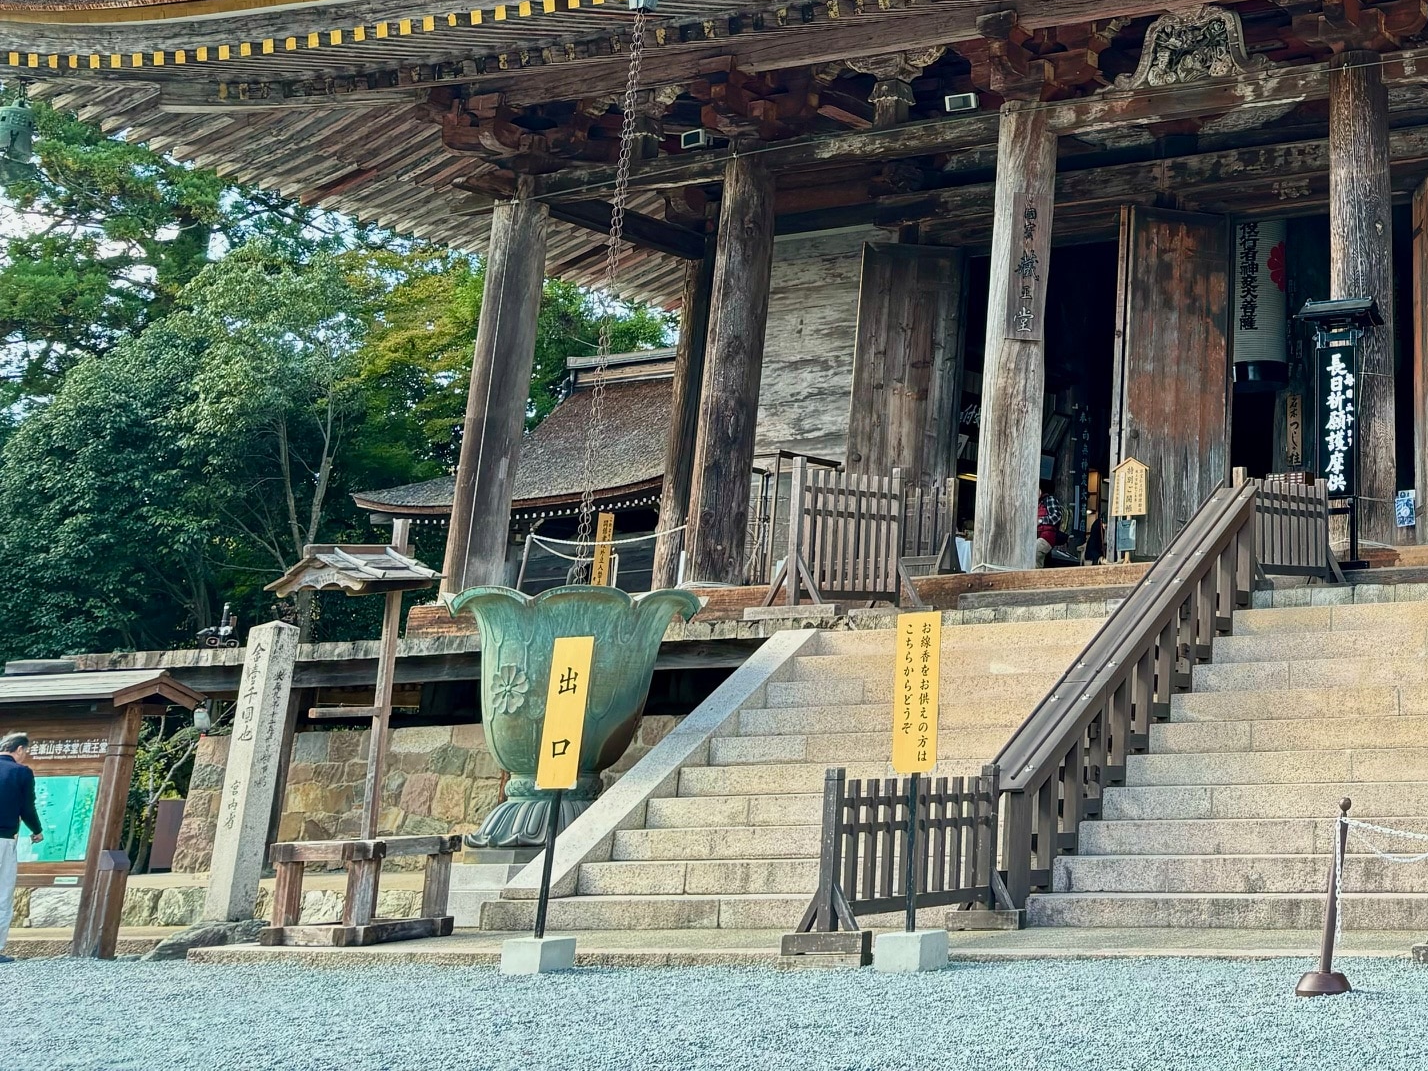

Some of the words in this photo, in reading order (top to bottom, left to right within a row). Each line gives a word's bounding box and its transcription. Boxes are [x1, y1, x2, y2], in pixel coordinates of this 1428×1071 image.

[1325, 353, 1349, 492] 長日祈願護摩供
[552, 667, 579, 759] 出口
[901, 624, 914, 734] こちらからどうぞ
[917, 622, 932, 762] お線香をお供えの方は
